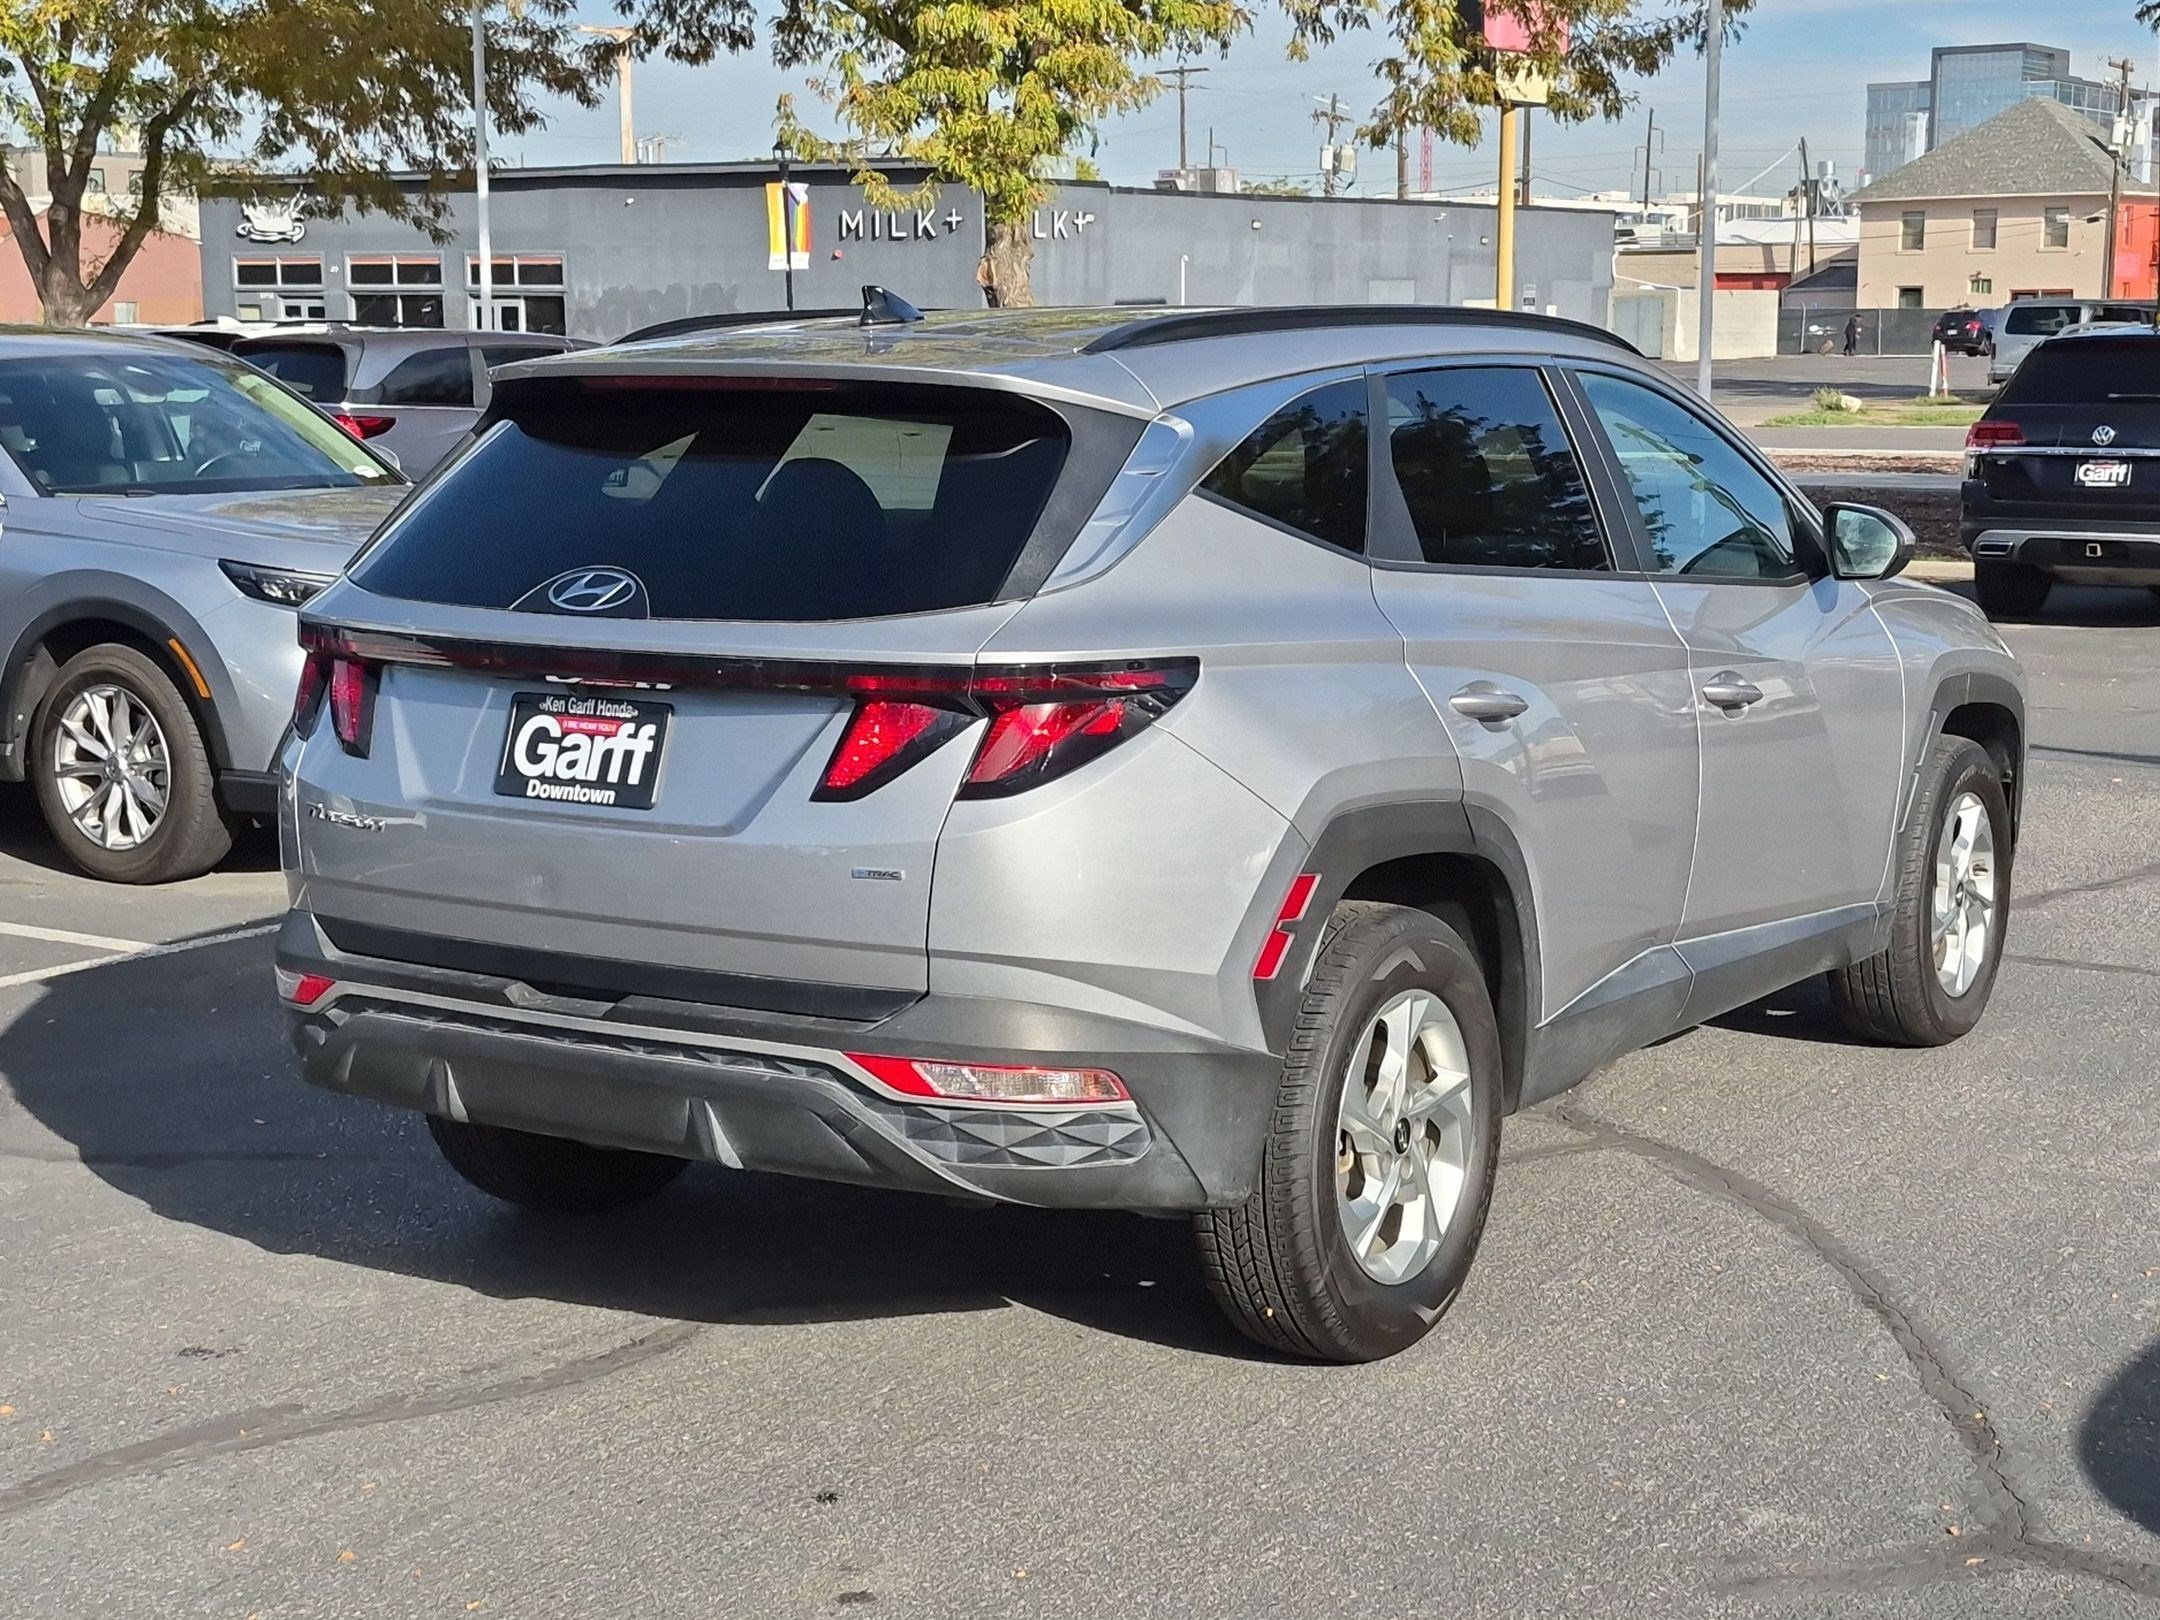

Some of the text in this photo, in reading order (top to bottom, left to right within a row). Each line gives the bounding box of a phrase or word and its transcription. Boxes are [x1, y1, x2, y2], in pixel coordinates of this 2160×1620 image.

[840, 207, 964, 241] MILK+
[1033, 210, 1087, 240] LK+
[2078, 463, 2128, 482] Garff
[545, 696, 634, 718] Ken Garff Honda
[513, 714, 657, 786] Garff
[526, 779, 616, 805] Downtown
